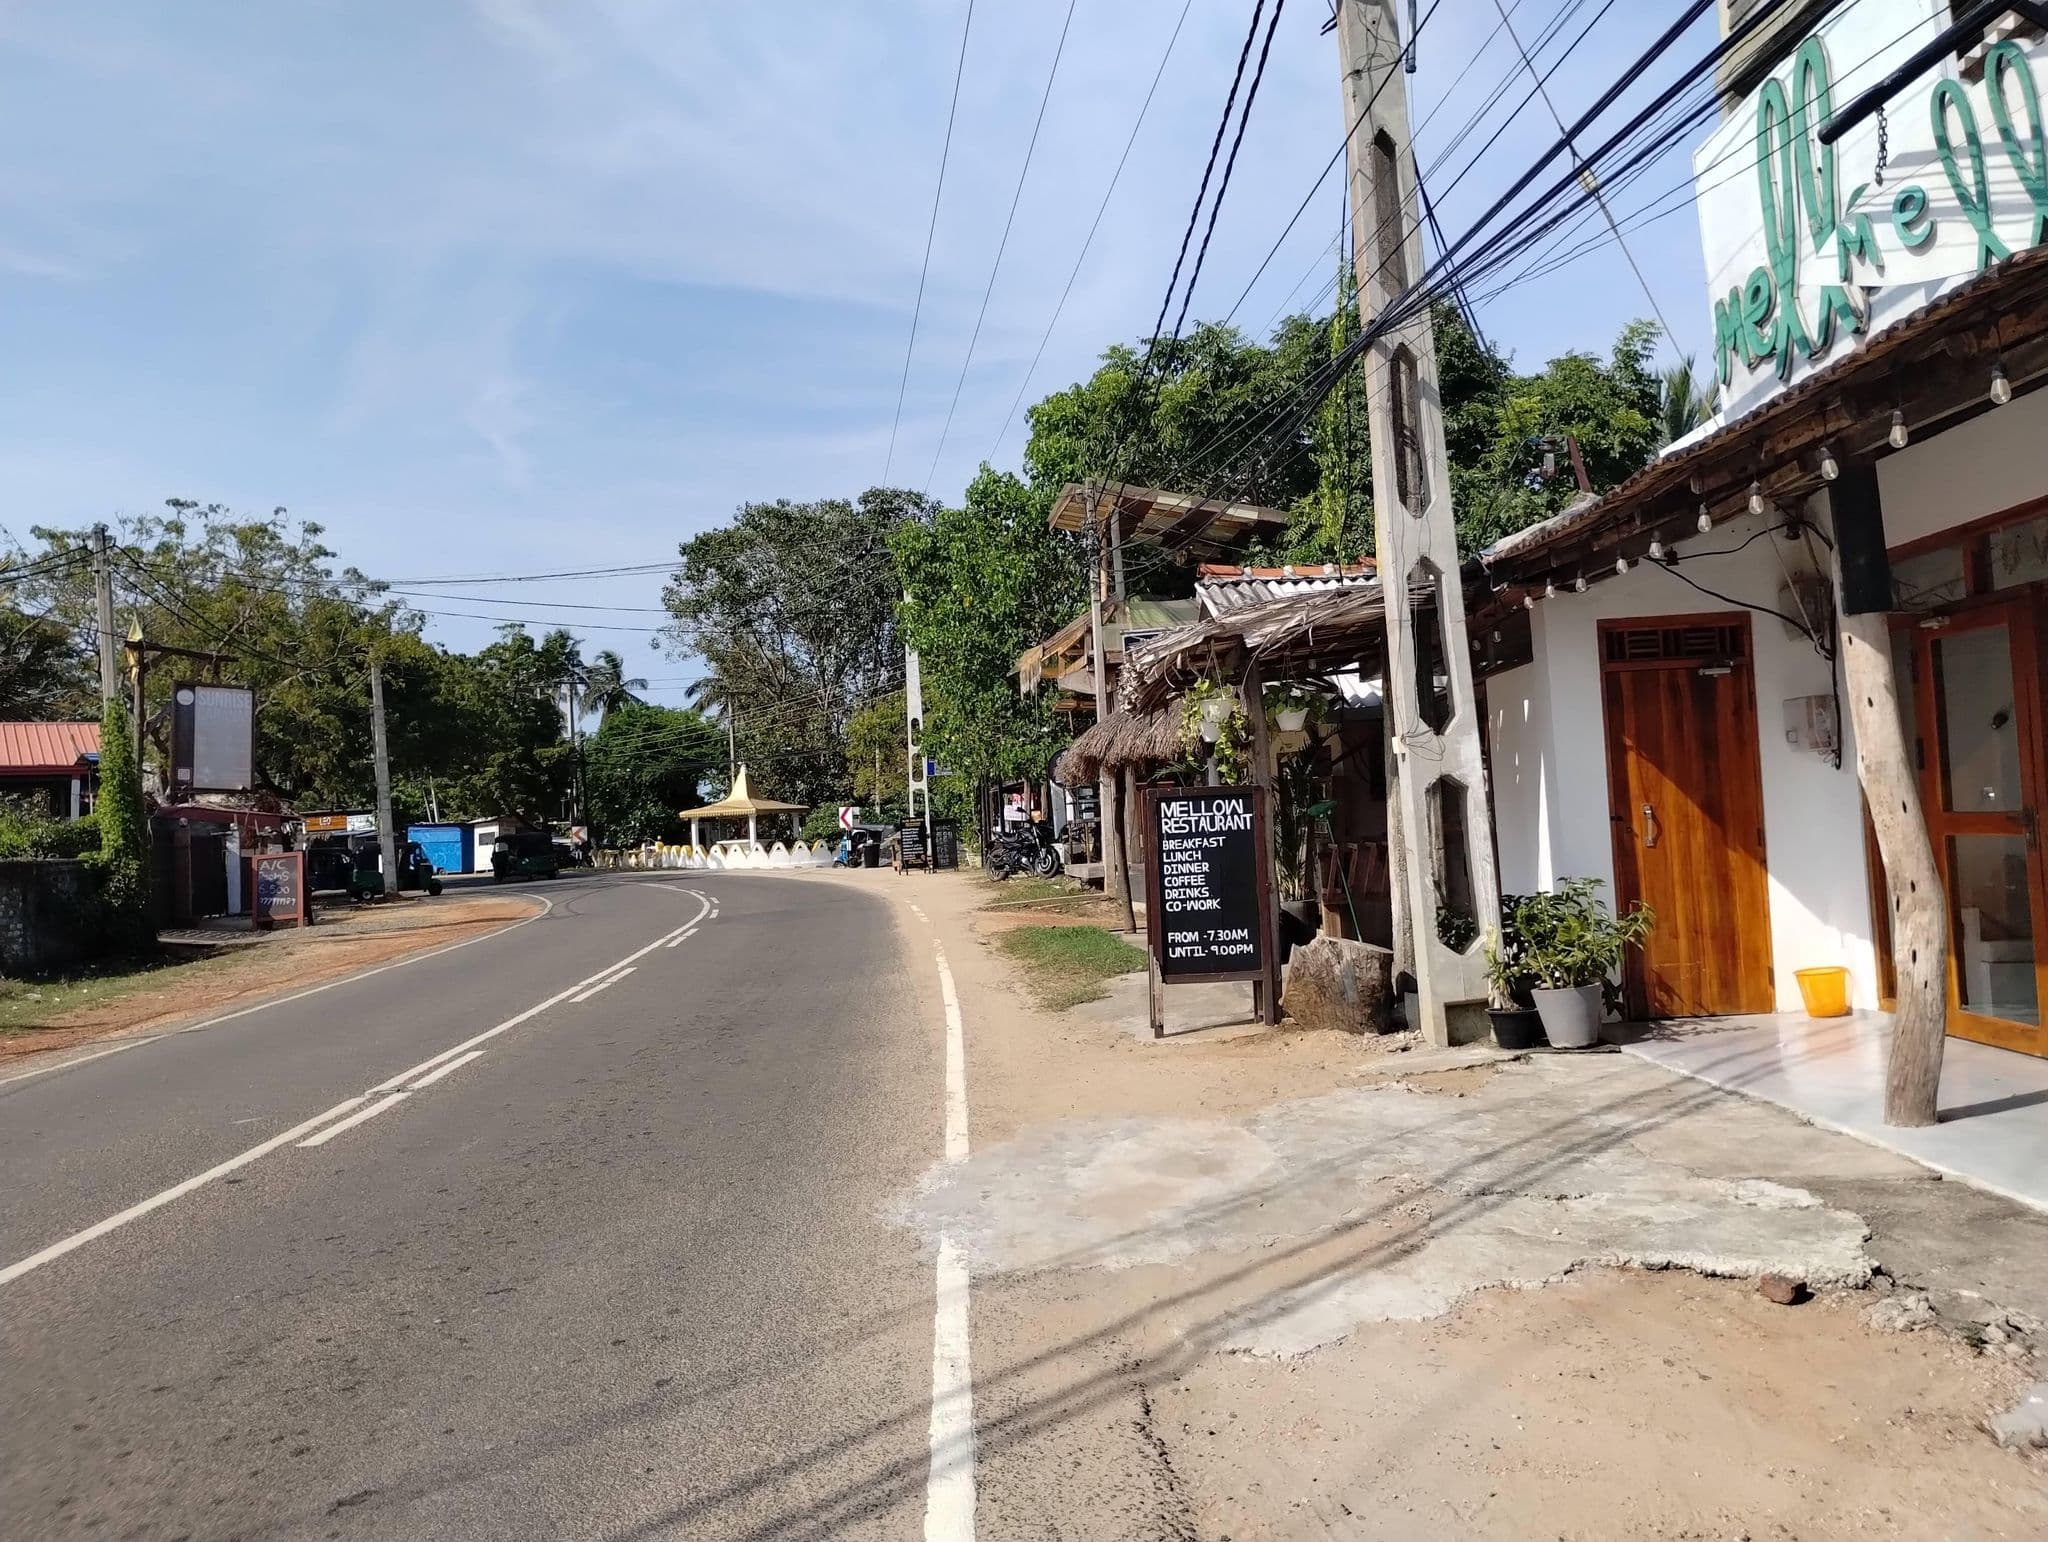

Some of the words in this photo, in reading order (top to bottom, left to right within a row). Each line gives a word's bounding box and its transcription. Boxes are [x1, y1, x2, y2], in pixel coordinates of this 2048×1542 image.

[1161, 799, 1244, 817] MELLOW
[1162, 814, 1253, 833] RESTAURANT
[1163, 836, 1225, 850] BREAKFAST
[1163, 851, 1201, 862] LUNCH
[260, 860, 286, 870] A/C
[1164, 863, 1209, 875] DINNER
[1164, 875, 1206, 887] COFFEE
[1165, 887, 1209, 899] DRINKS
[1166, 898, 1221, 912] CO-WORK
[1168, 932, 1199, 943] FROM
